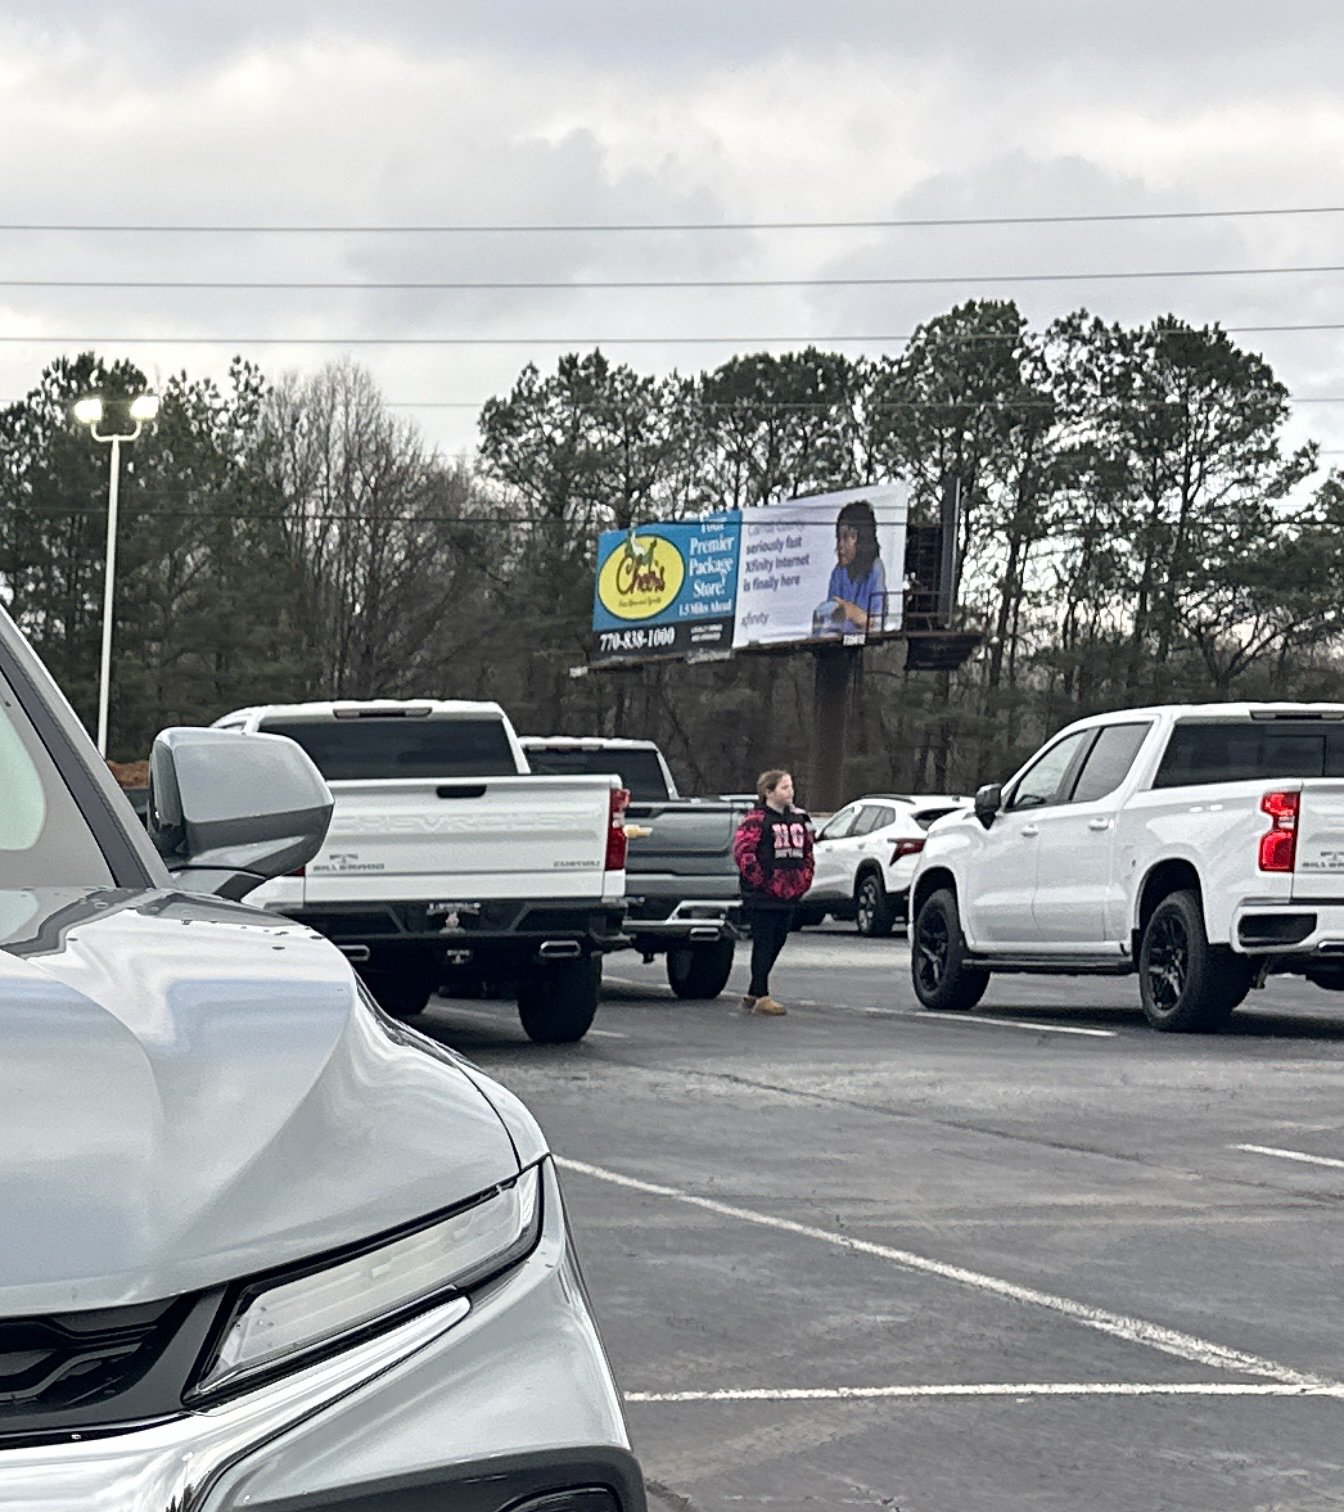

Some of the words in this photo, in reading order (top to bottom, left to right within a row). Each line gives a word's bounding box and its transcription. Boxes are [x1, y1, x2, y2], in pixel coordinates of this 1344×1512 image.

[689, 534, 735, 556] Premier
[786, 535, 802, 549] fast
[689, 557, 734, 577] Package
[693, 574, 726, 598] Store!
[753, 575, 779, 592] finally
[780, 573, 801, 587] here
